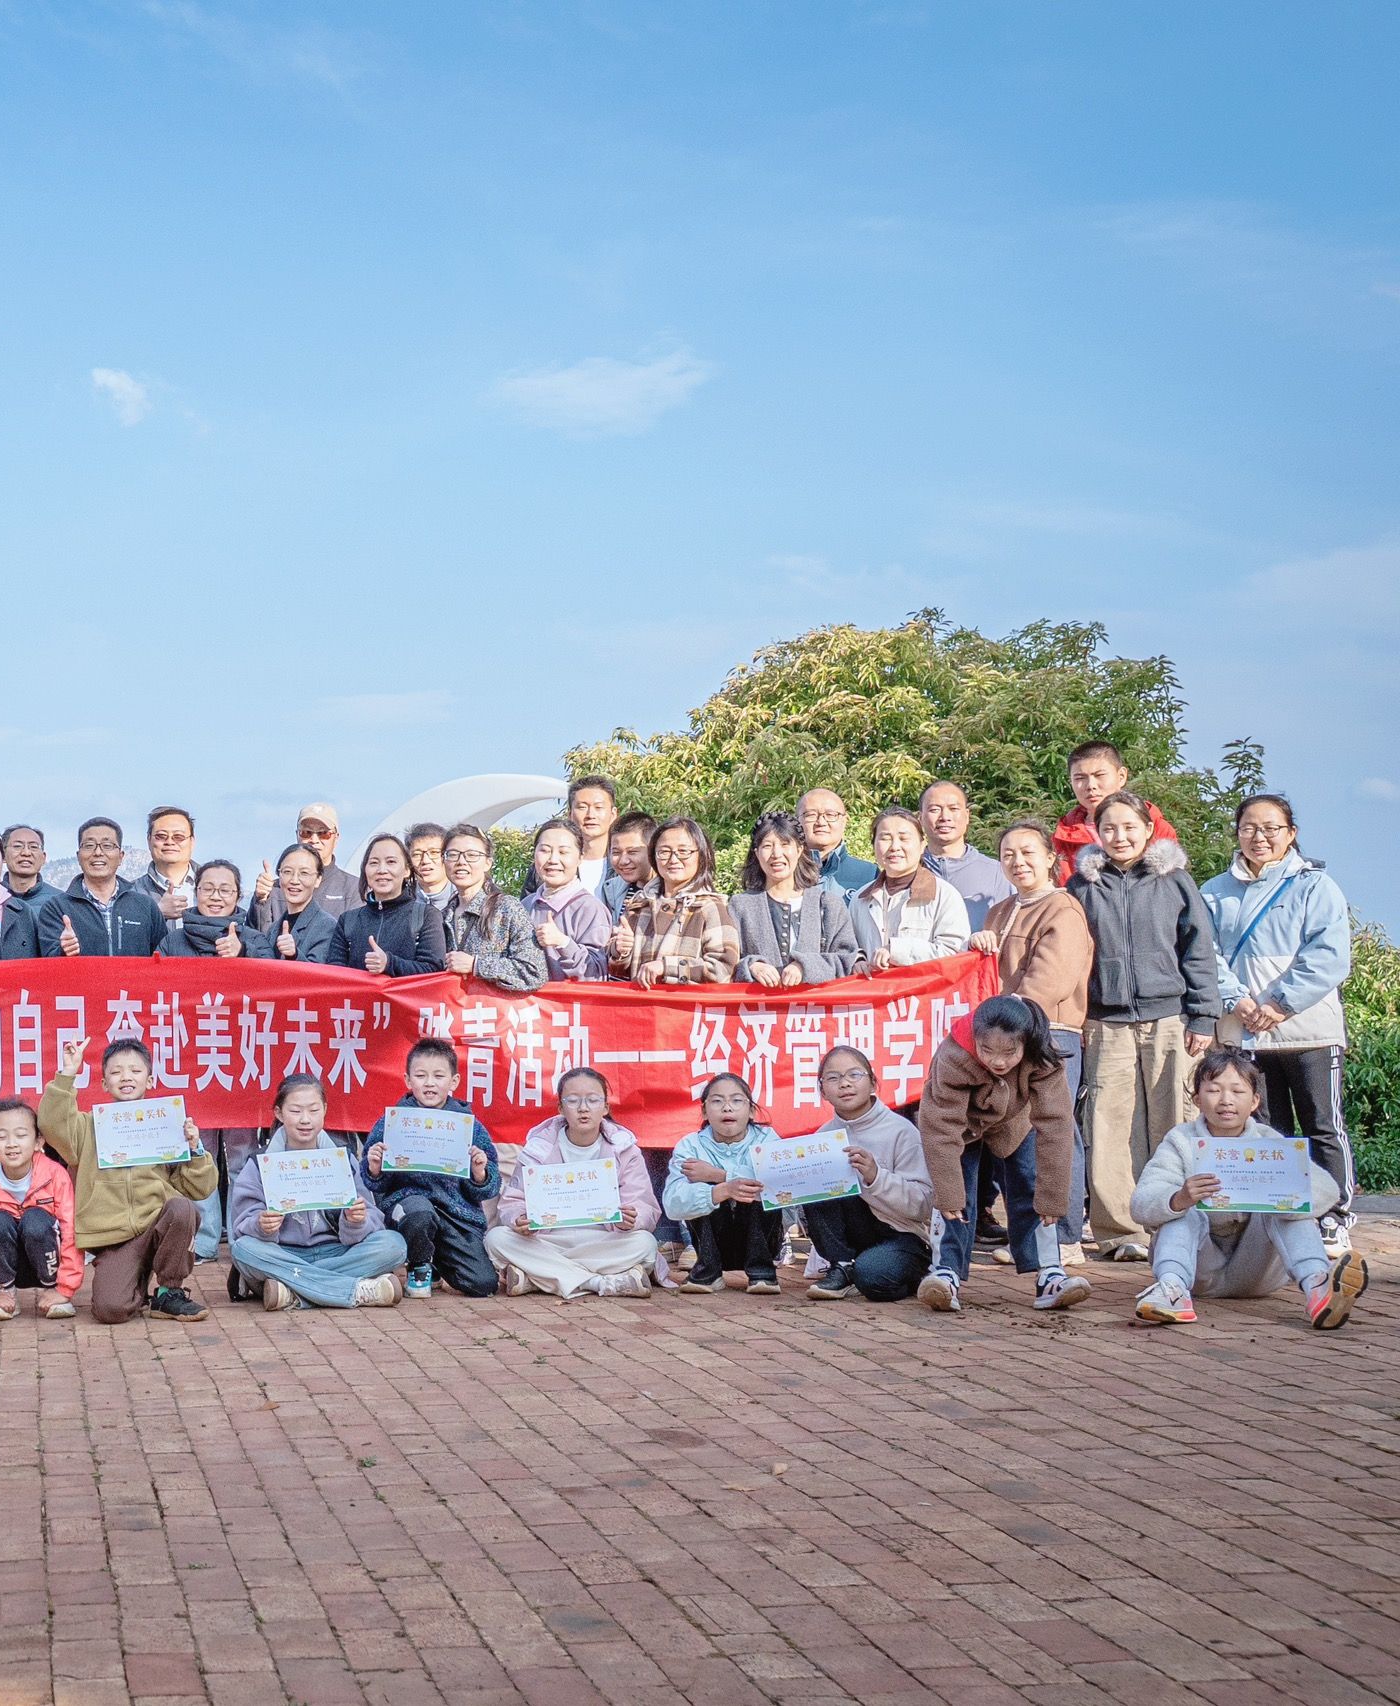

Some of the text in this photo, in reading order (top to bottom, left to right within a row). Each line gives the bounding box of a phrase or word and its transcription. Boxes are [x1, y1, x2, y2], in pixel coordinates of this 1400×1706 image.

[1215, 1148, 1285, 1161] 荣誉 奖状
[44, 1249, 59, 1277] FILA
